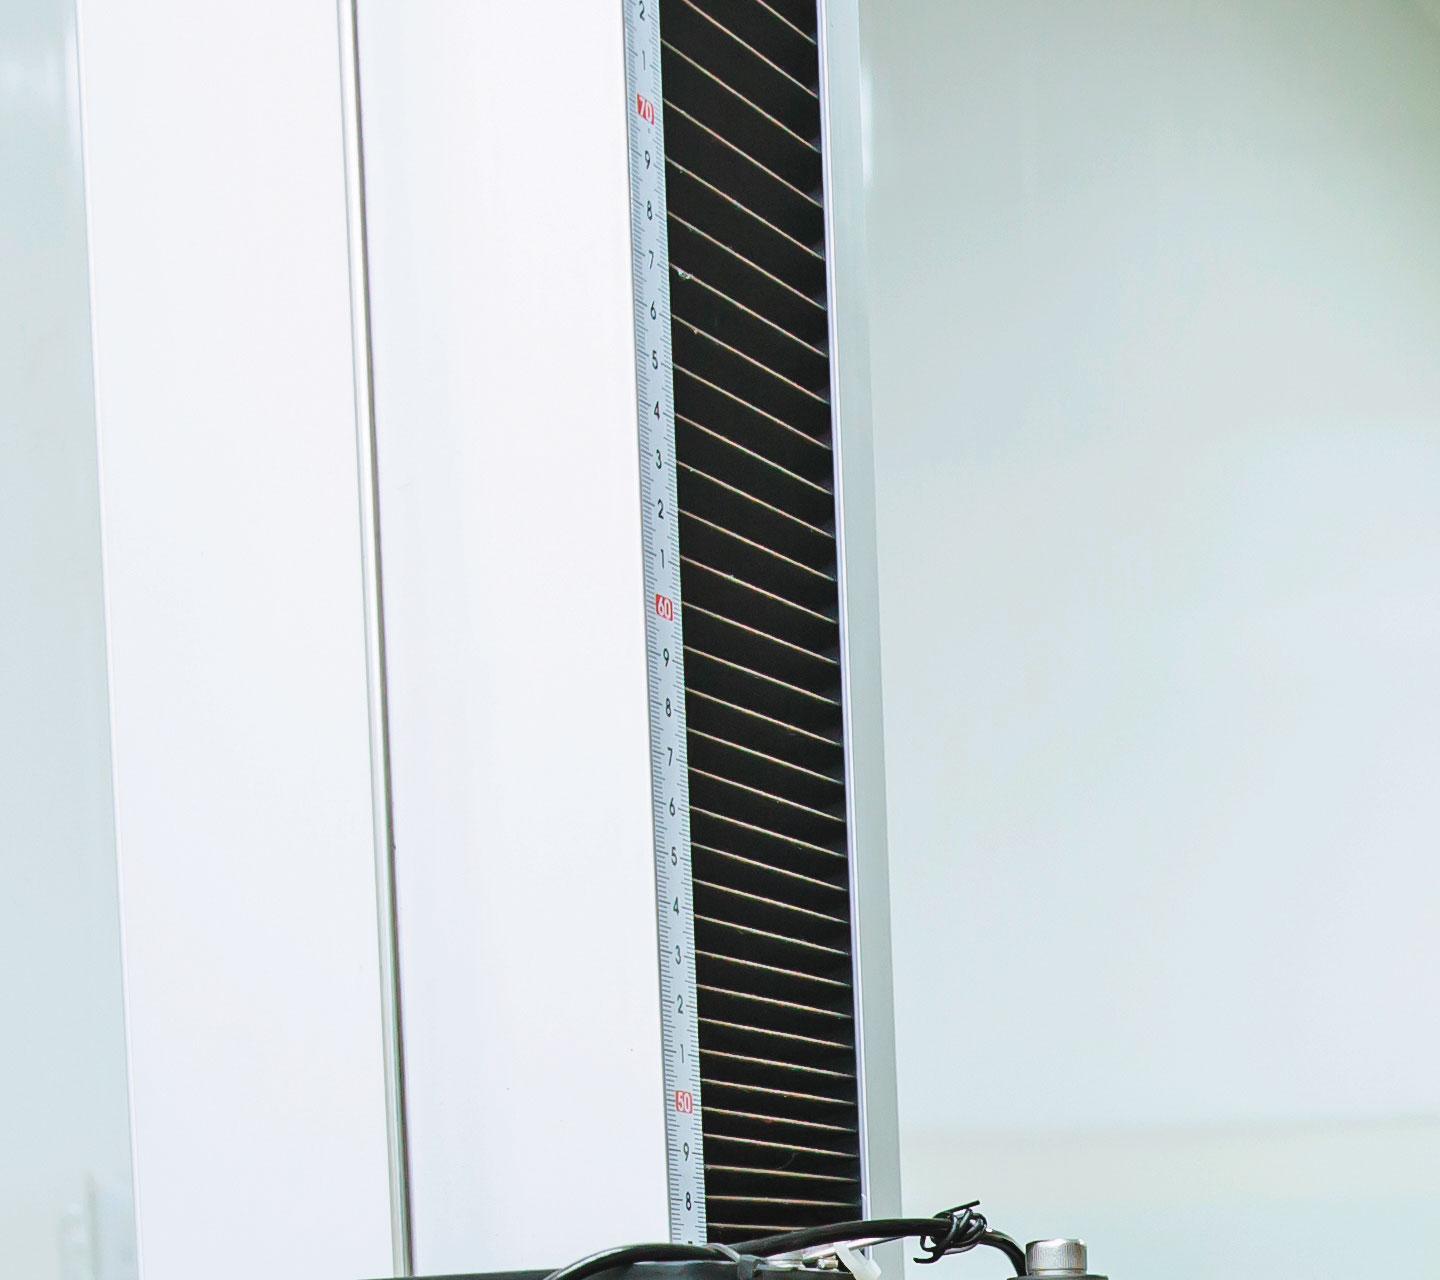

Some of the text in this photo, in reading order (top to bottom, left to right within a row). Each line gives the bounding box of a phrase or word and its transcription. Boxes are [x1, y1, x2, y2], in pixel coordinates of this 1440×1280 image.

[638, 95, 654, 123] 70
[656, 596, 672, 620] 60
[676, 1091, 692, 1113] 50
